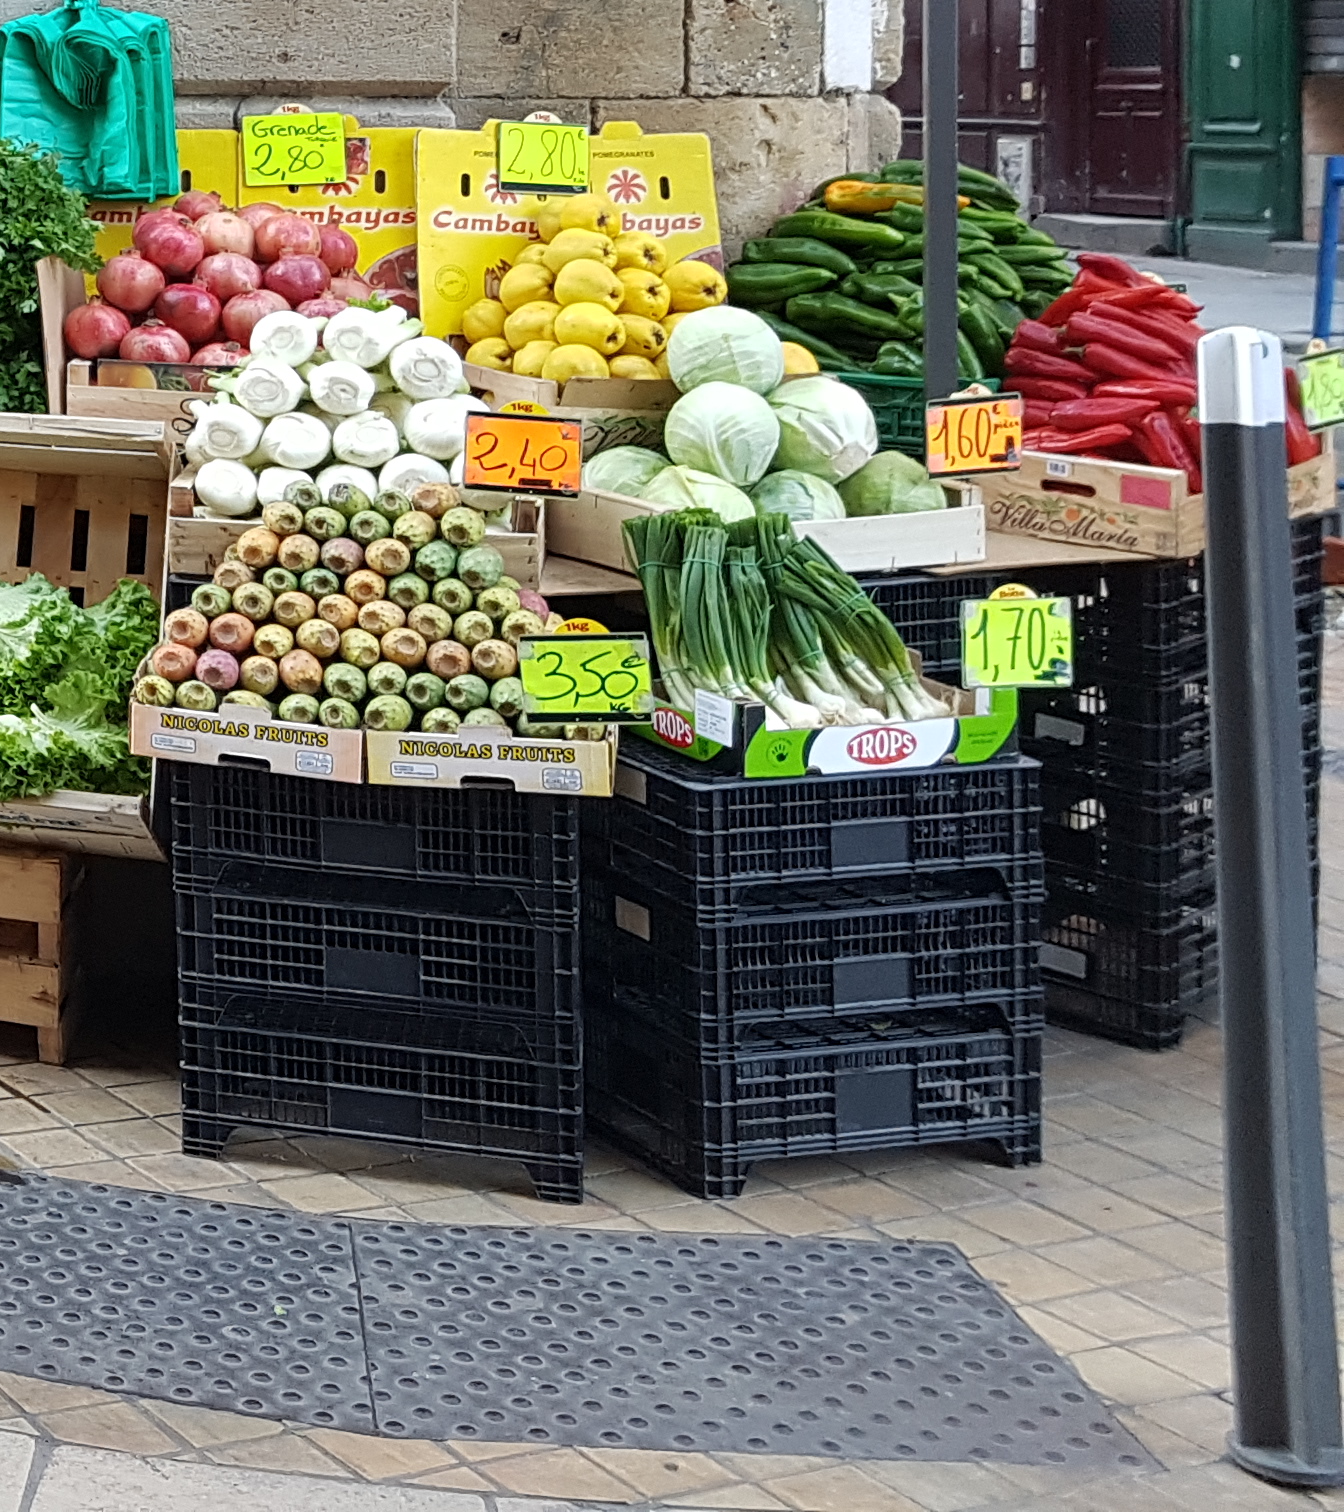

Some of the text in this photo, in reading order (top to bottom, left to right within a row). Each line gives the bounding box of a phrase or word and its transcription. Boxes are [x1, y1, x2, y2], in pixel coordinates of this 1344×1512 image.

[252, 116, 336, 139] Grenade
[592, 150, 655, 159] POMEGRANATES
[510, 403, 533, 413] 1kg
[990, 500, 1047, 533] Villa
[565, 622, 589, 632] 1kg
[161, 713, 329, 747] NICOLAS FRUITS
[399, 740, 576, 763] NICOLAS FRUITS
[849, 732, 914, 760] TROPS
